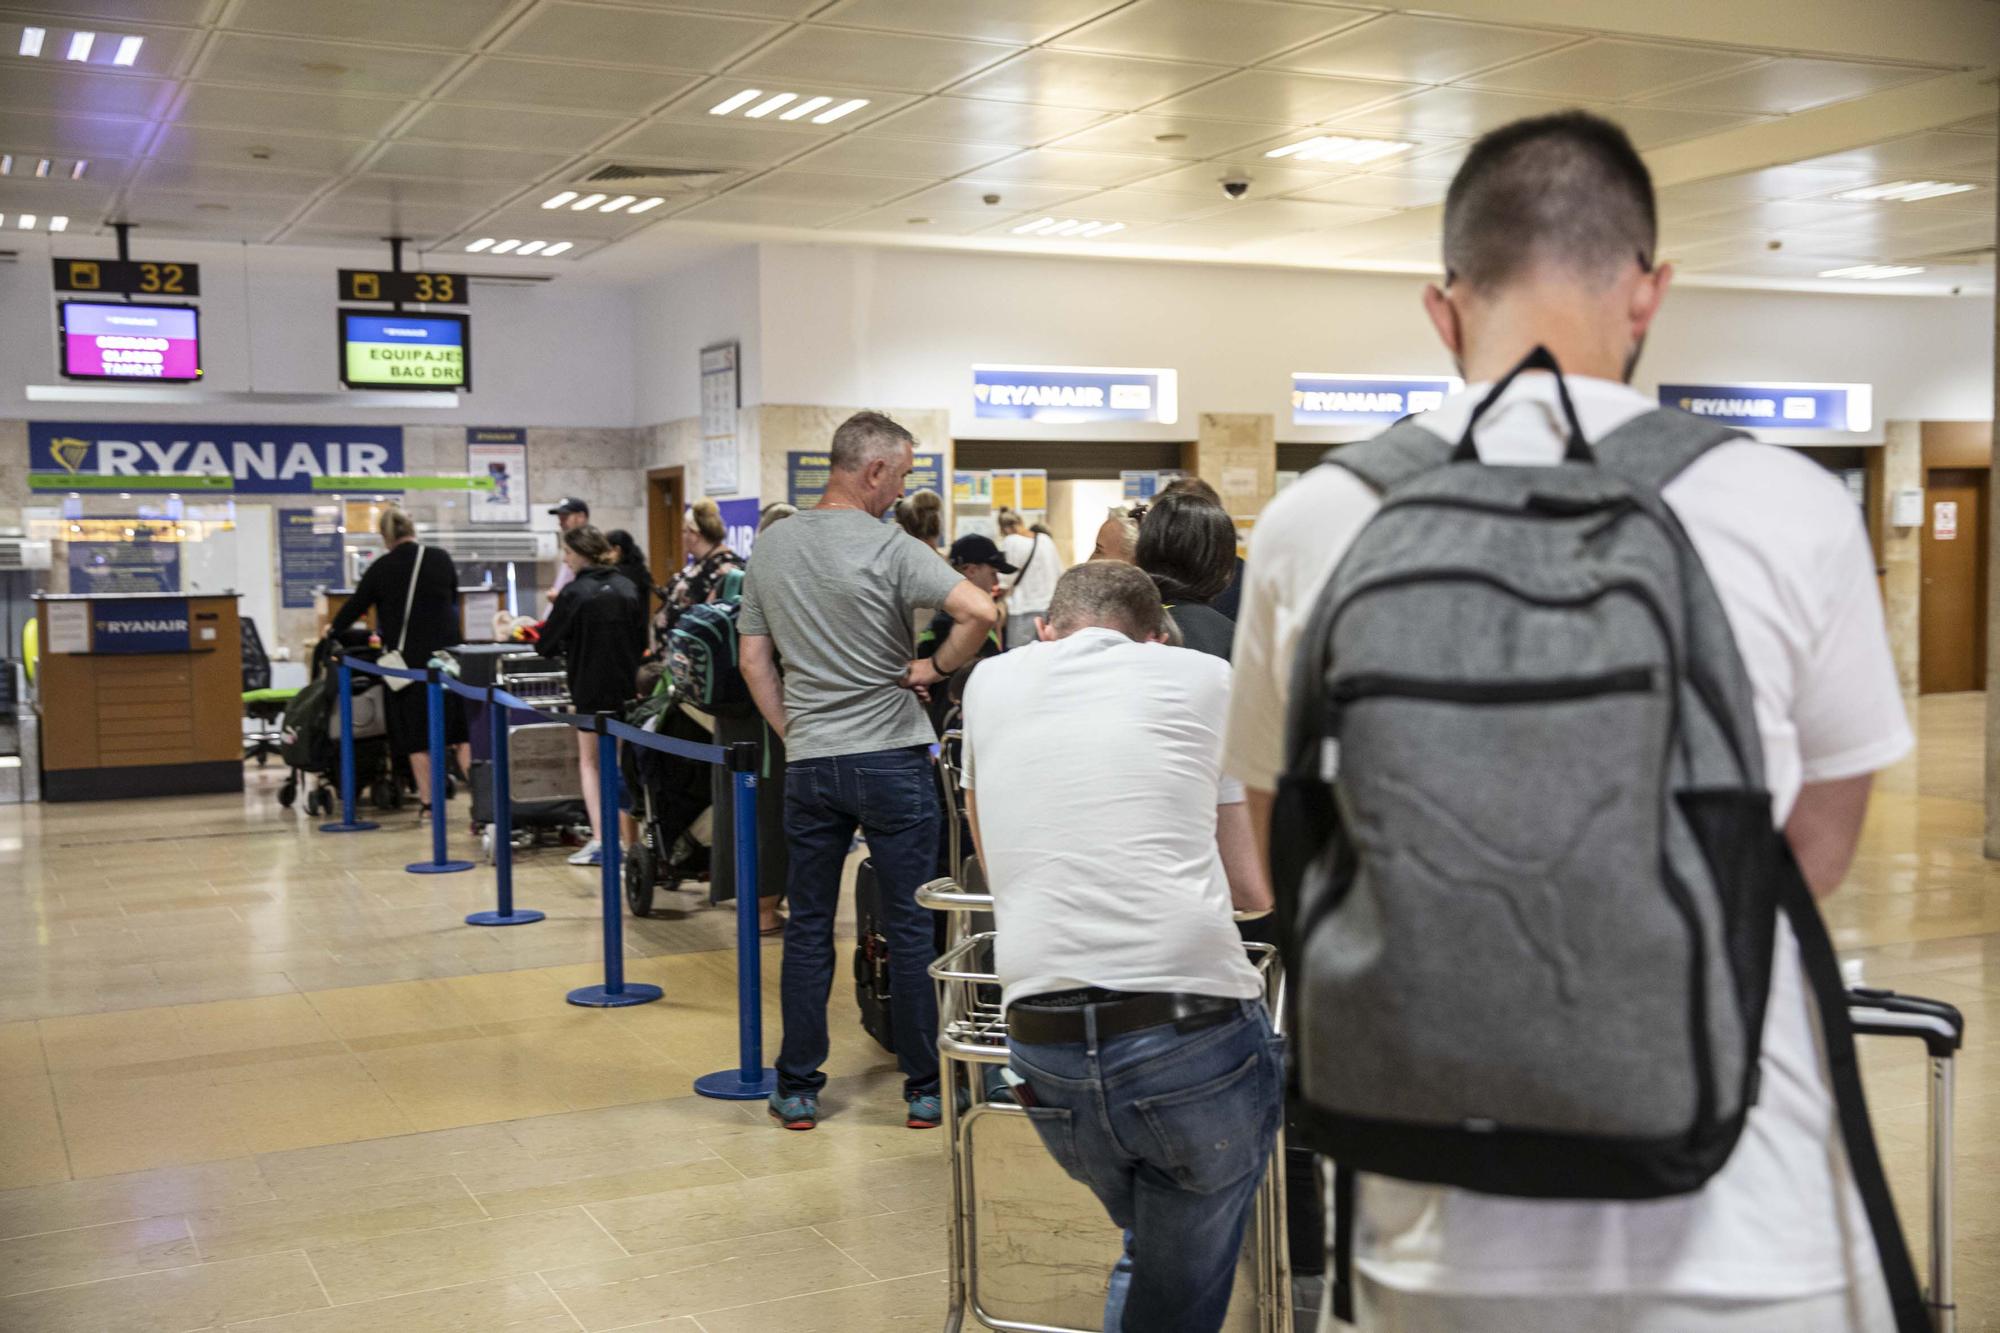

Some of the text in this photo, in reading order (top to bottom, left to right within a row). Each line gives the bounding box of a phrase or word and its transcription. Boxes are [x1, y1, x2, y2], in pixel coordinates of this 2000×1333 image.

[140, 264, 185, 294] 32
[415, 275, 454, 302] 33
[390, 366, 425, 378] BAG
[990, 384, 1104, 408] RYANAIR
[1303, 390, 1402, 412] RYANAIR
[1690, 397, 1776, 418] RYANAIR
[97, 440, 389, 481] RYANAIR
[107, 619, 189, 634] RYANAIR
